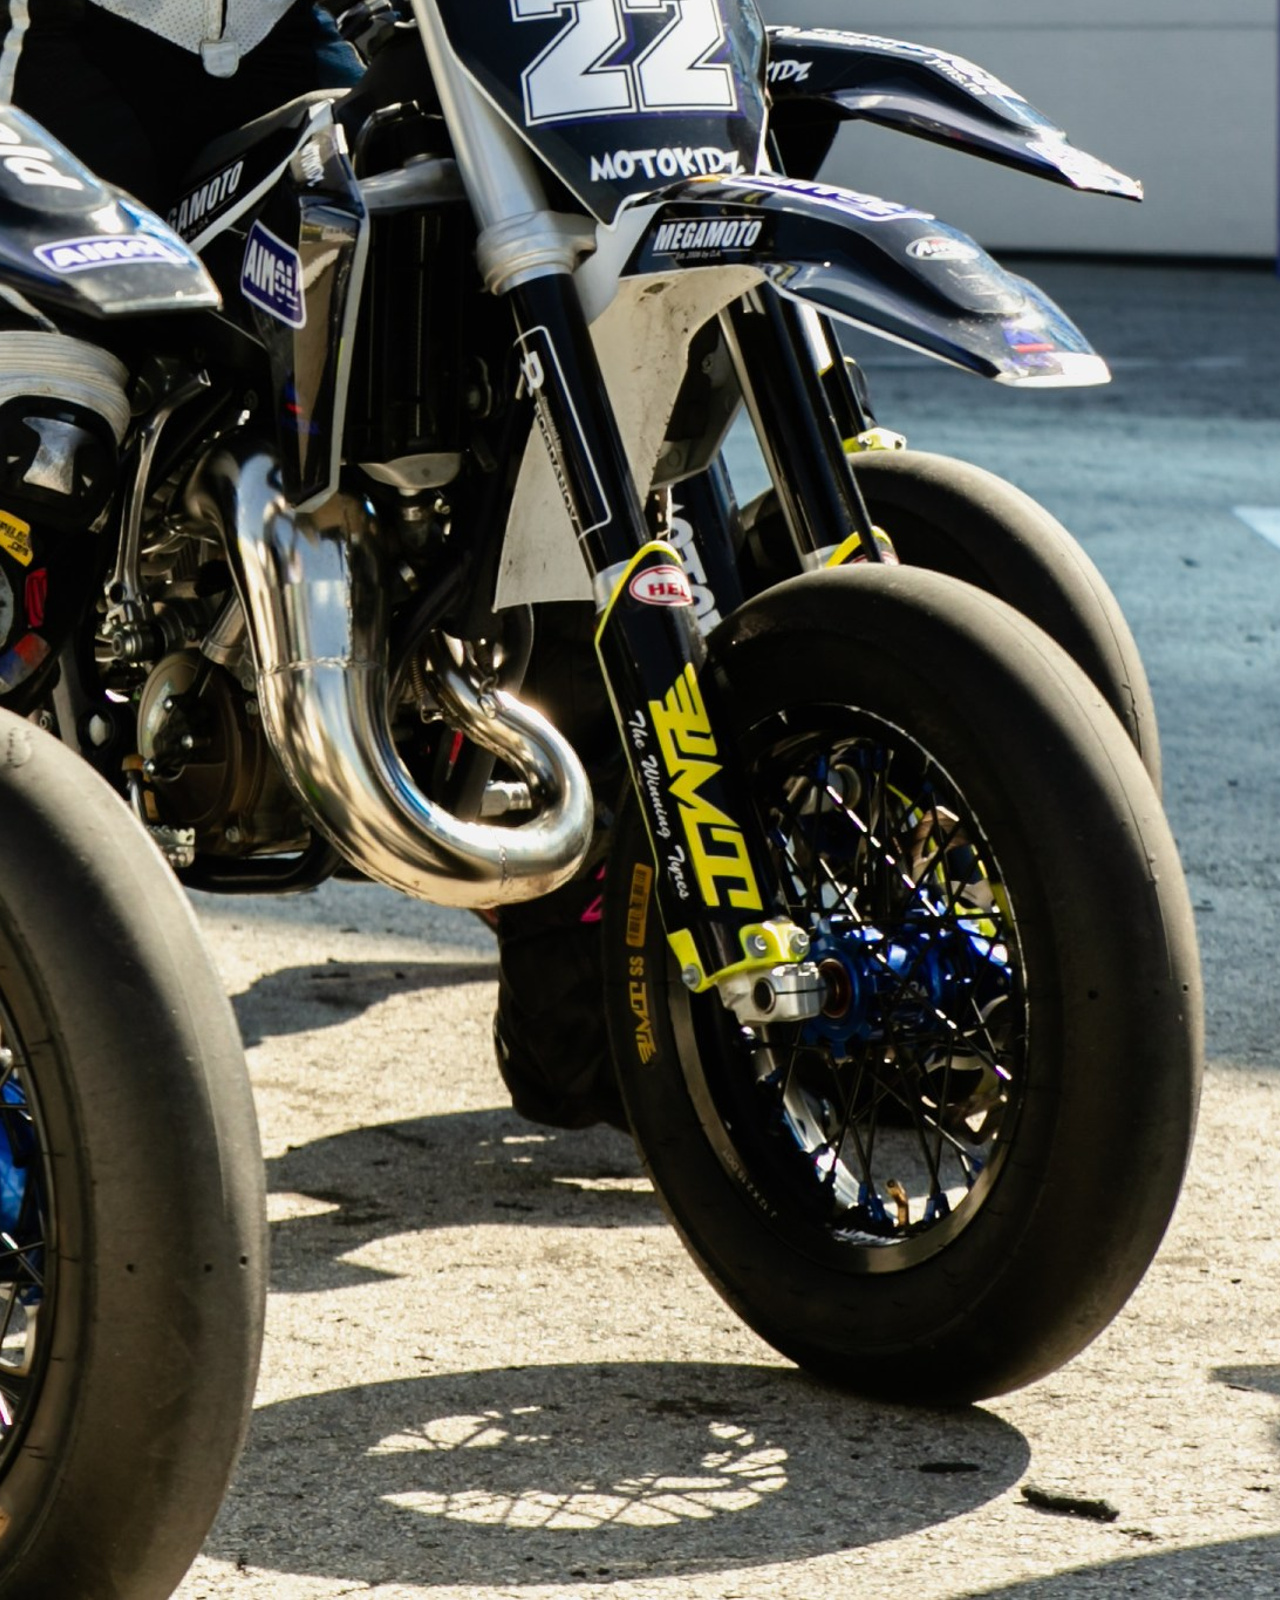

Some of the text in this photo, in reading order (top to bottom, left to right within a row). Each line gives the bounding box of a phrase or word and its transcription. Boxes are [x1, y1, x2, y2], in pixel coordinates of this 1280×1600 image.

[590, 147, 746, 182] MOTOKIDZ
[652, 220, 763, 252] MEGAMOTO
[629, 710, 690, 901] The Winning Tyres
[647, 661, 764, 912] DMT
